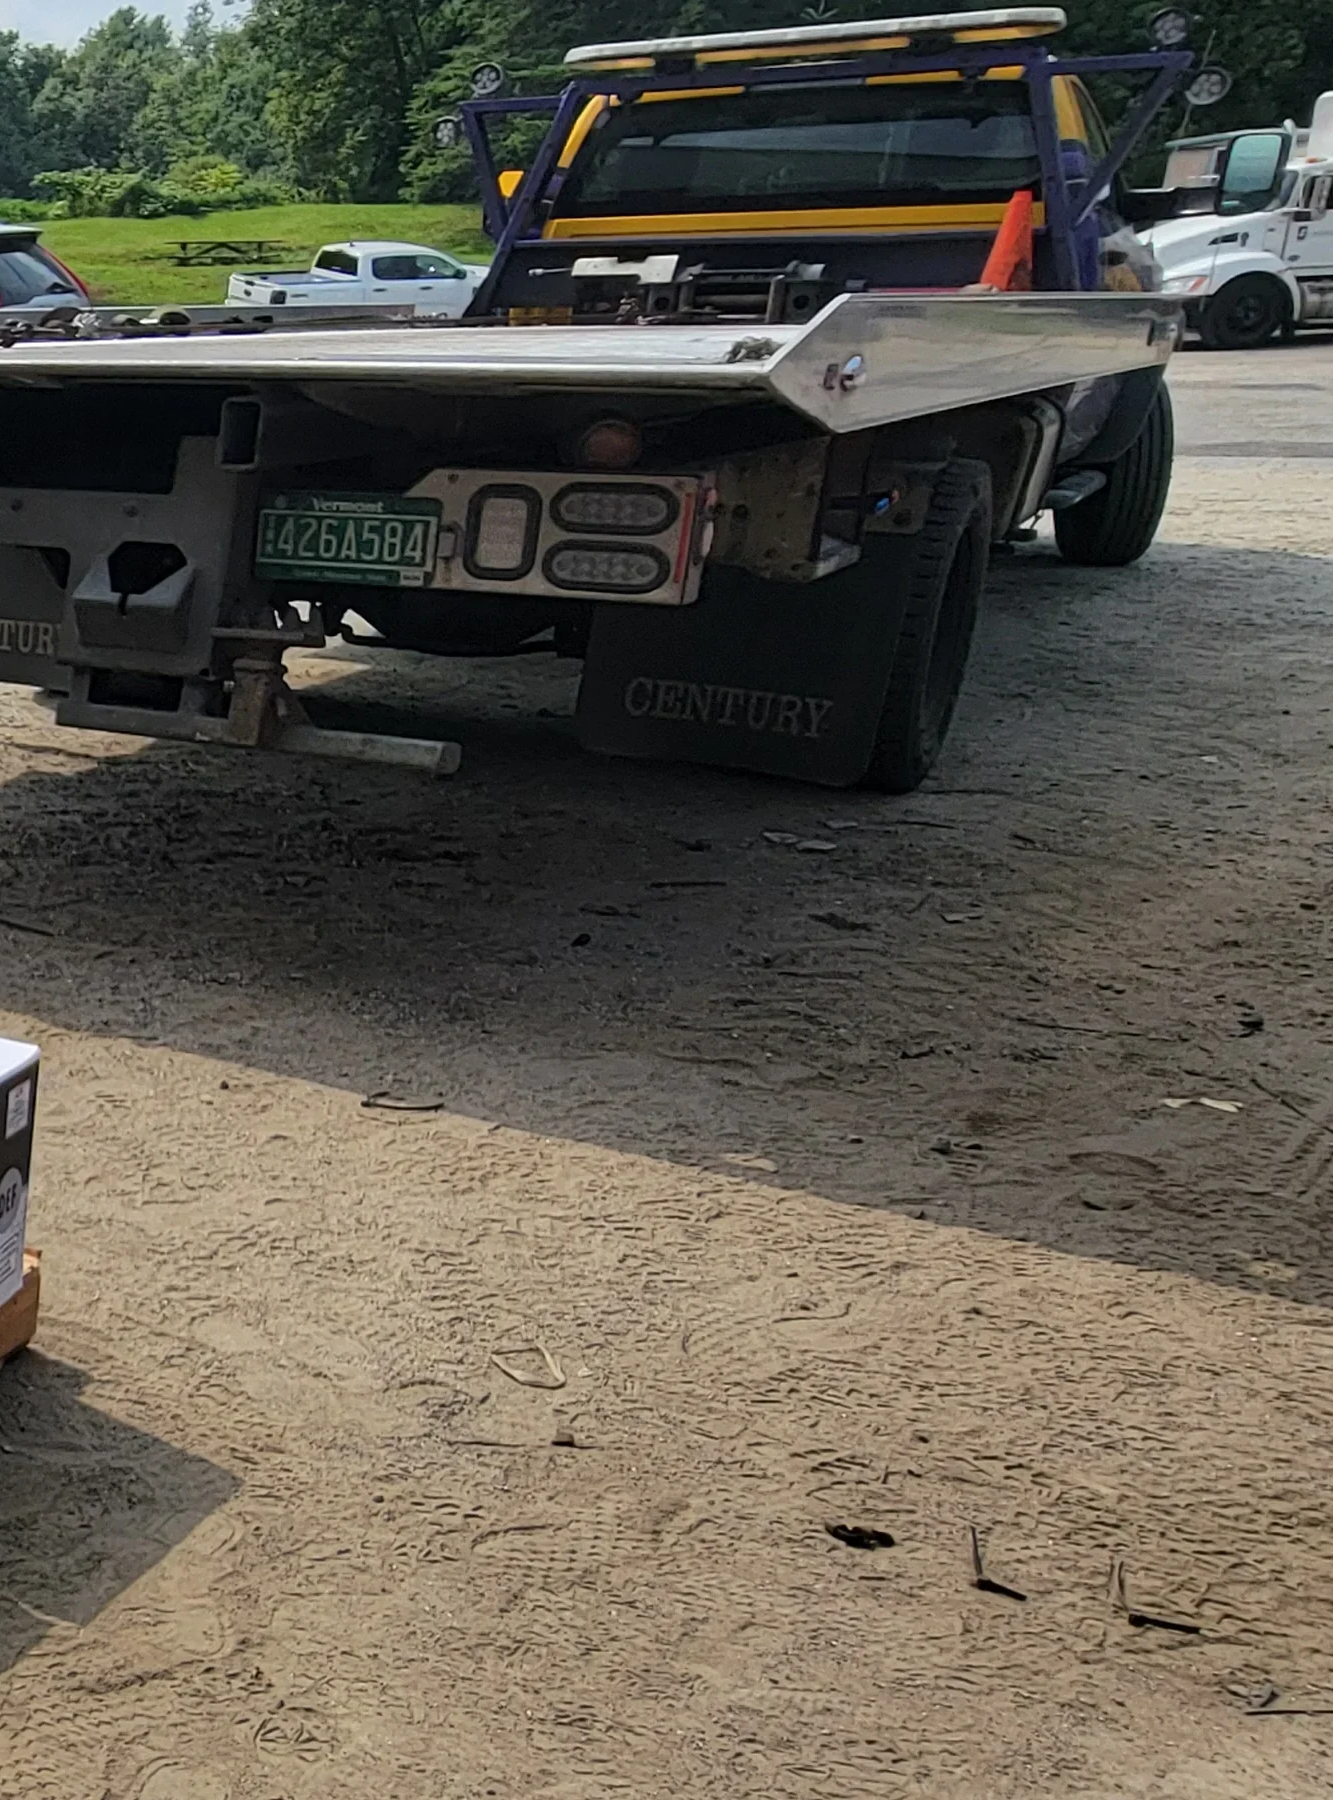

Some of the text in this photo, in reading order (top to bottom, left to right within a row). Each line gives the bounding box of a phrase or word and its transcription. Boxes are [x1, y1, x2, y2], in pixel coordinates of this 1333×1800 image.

[311, 496, 385, 513] Vermont
[276, 516, 425, 564] 426A584
[625, 676, 833, 739] CENTURY
